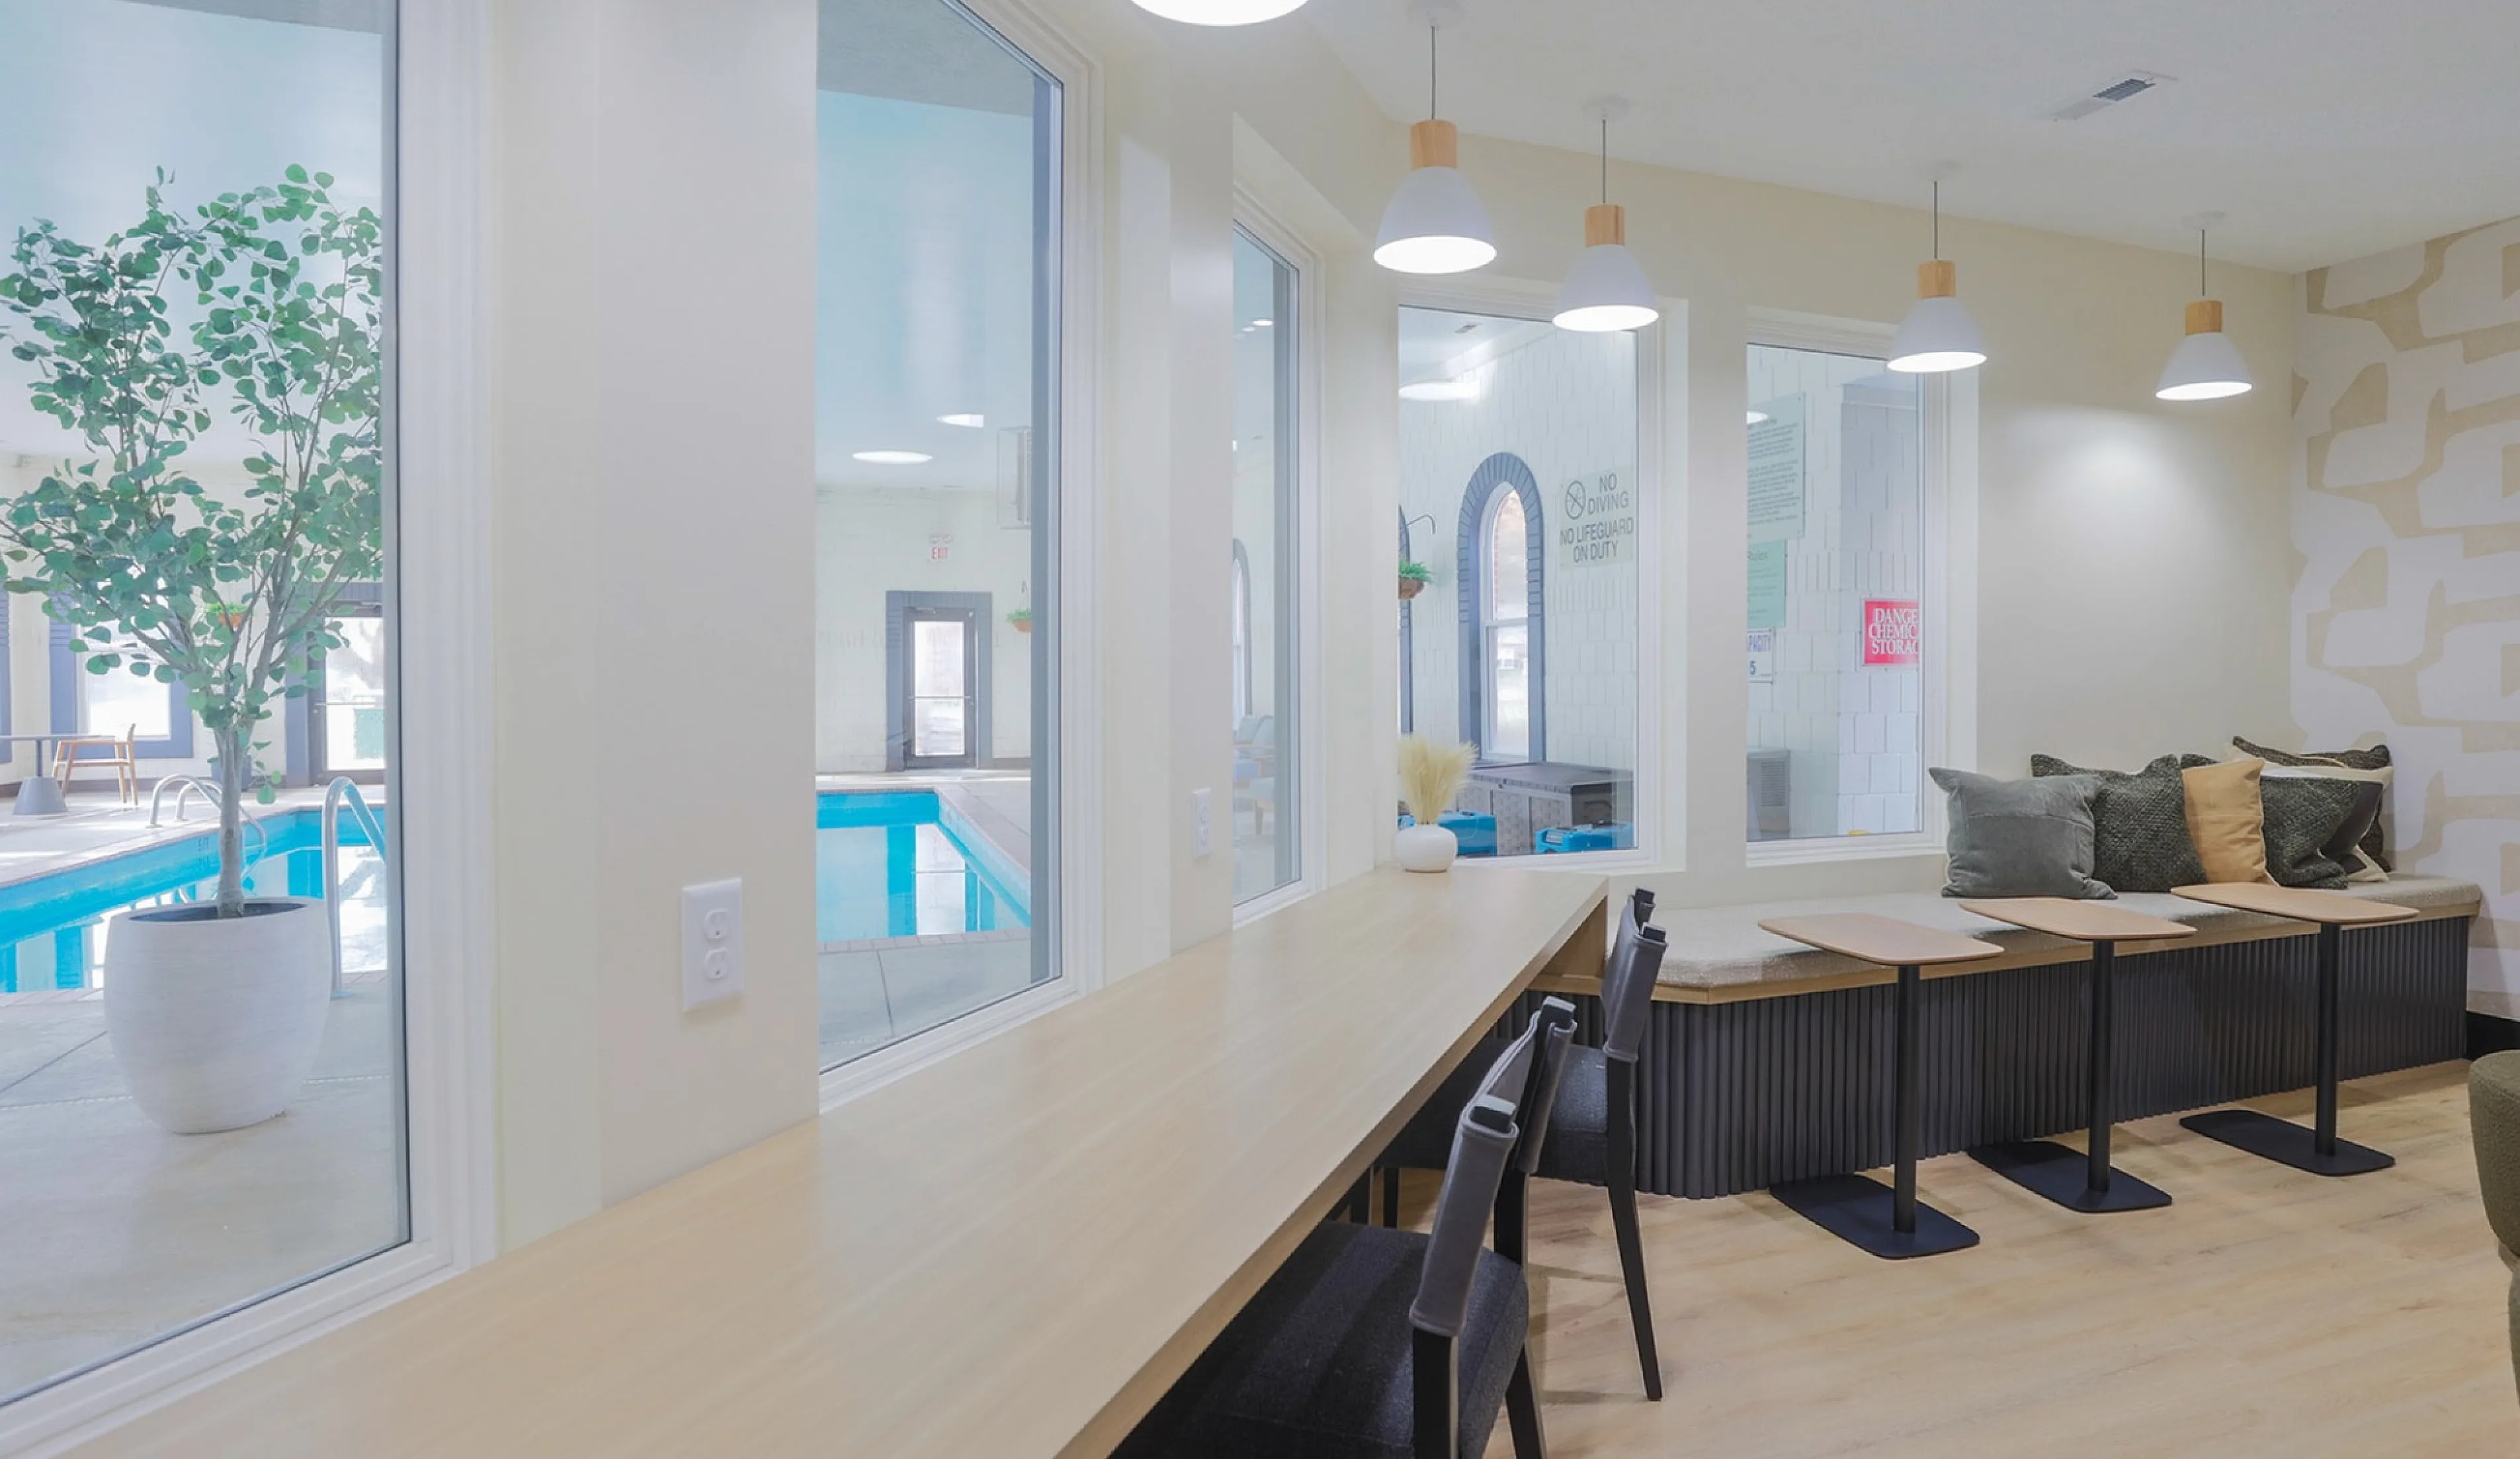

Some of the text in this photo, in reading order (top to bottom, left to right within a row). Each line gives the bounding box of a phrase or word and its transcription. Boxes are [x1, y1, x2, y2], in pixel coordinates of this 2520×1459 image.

[1599, 472, 1617, 493] NO
[1588, 491, 1629, 515] DIVING
[1560, 517, 1634, 546] NO LIFEGUARD
[1574, 540, 1618, 563] ON DUTY
[1874, 608, 1918, 623] DANGE
[1869, 624, 1918, 639] CHEMIC
